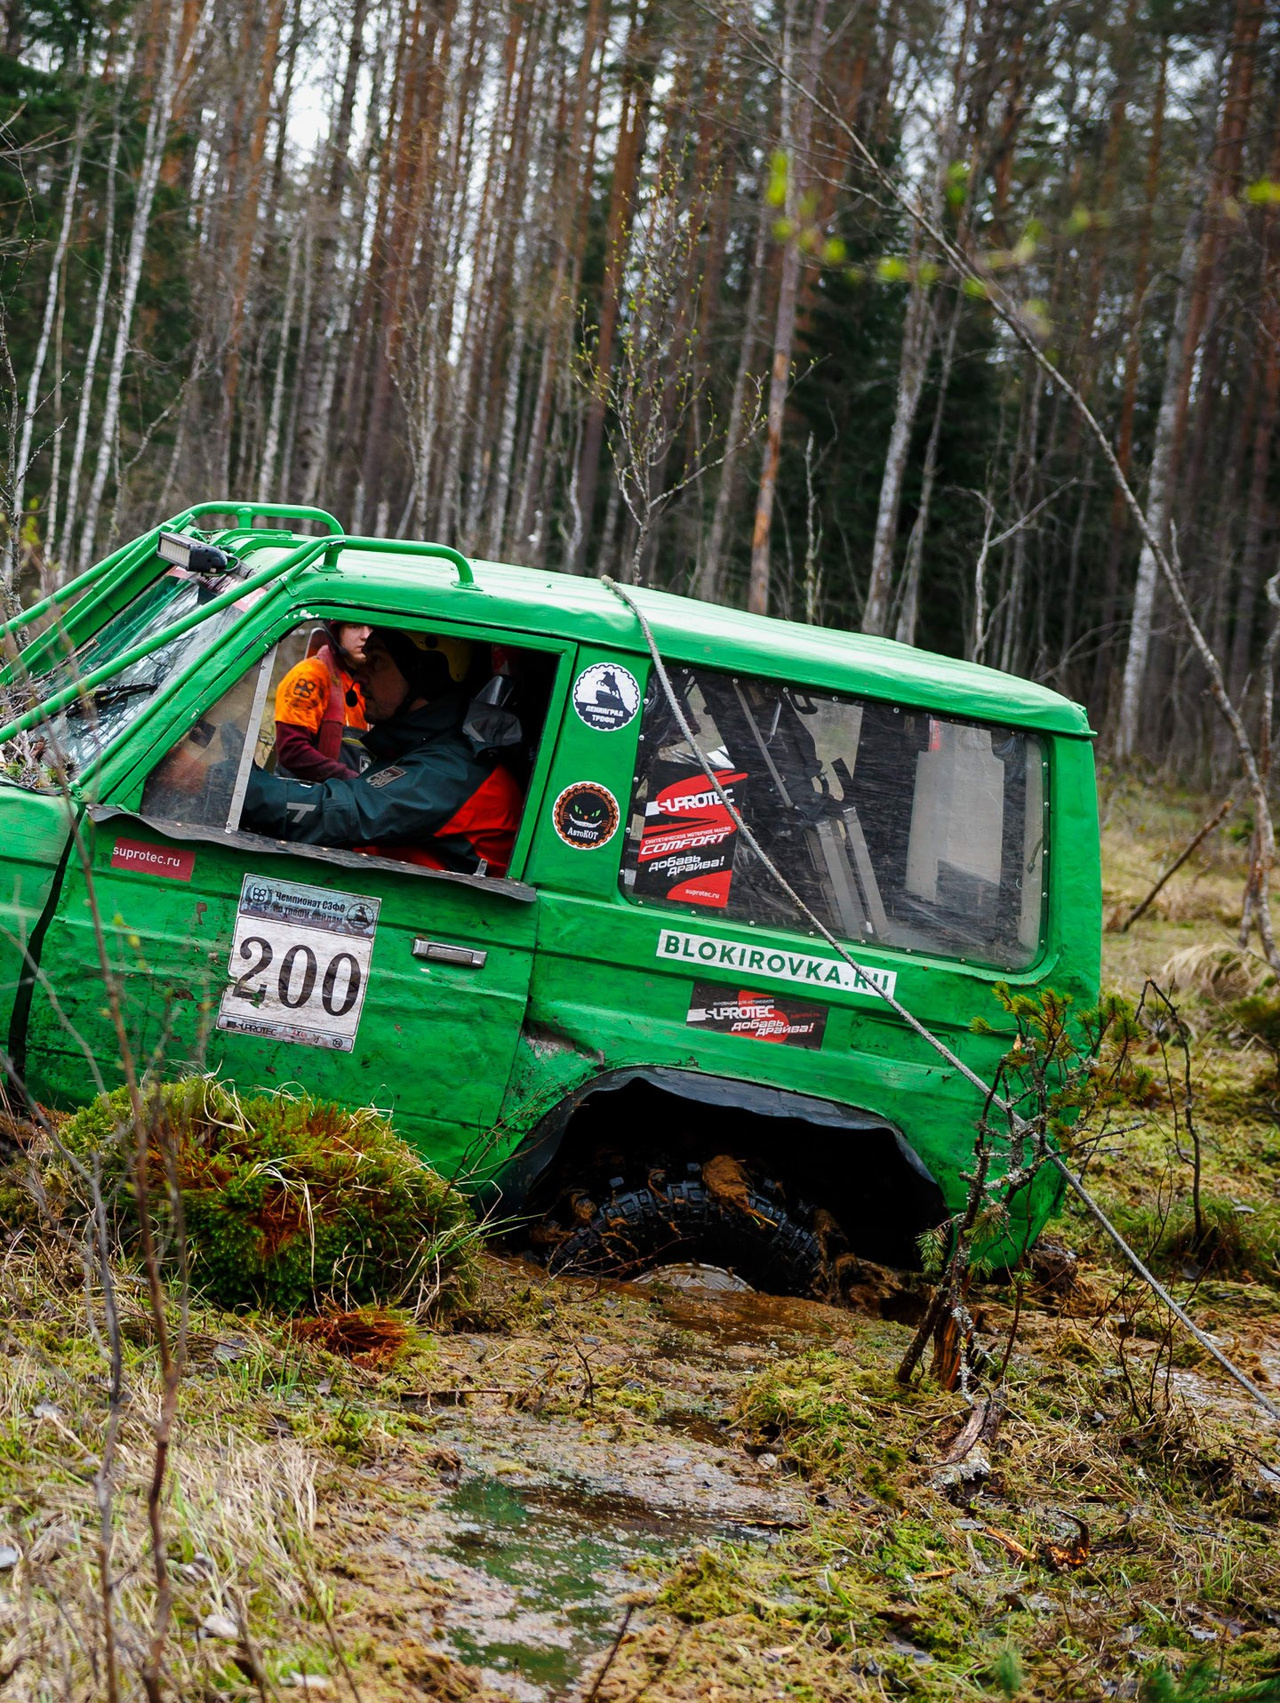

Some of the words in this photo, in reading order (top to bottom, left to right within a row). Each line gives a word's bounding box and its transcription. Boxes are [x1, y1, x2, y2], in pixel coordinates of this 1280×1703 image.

[640, 832, 730, 855] COMFORT
[112, 846, 181, 867] suprotec.ru
[648, 855, 702, 872] добавь
[667, 856, 725, 877] драйва!
[276, 891, 321, 908] Чемпионат
[685, 888, 720, 899] suprotec.ru
[664, 934, 889, 992] BLOKIROVKA.RU
[232, 936, 361, 1017] 200
[704, 1005, 775, 1020] SUPROTEC
[731, 1019, 784, 1031] добавь
[755, 1022, 815, 1037] драйва!
